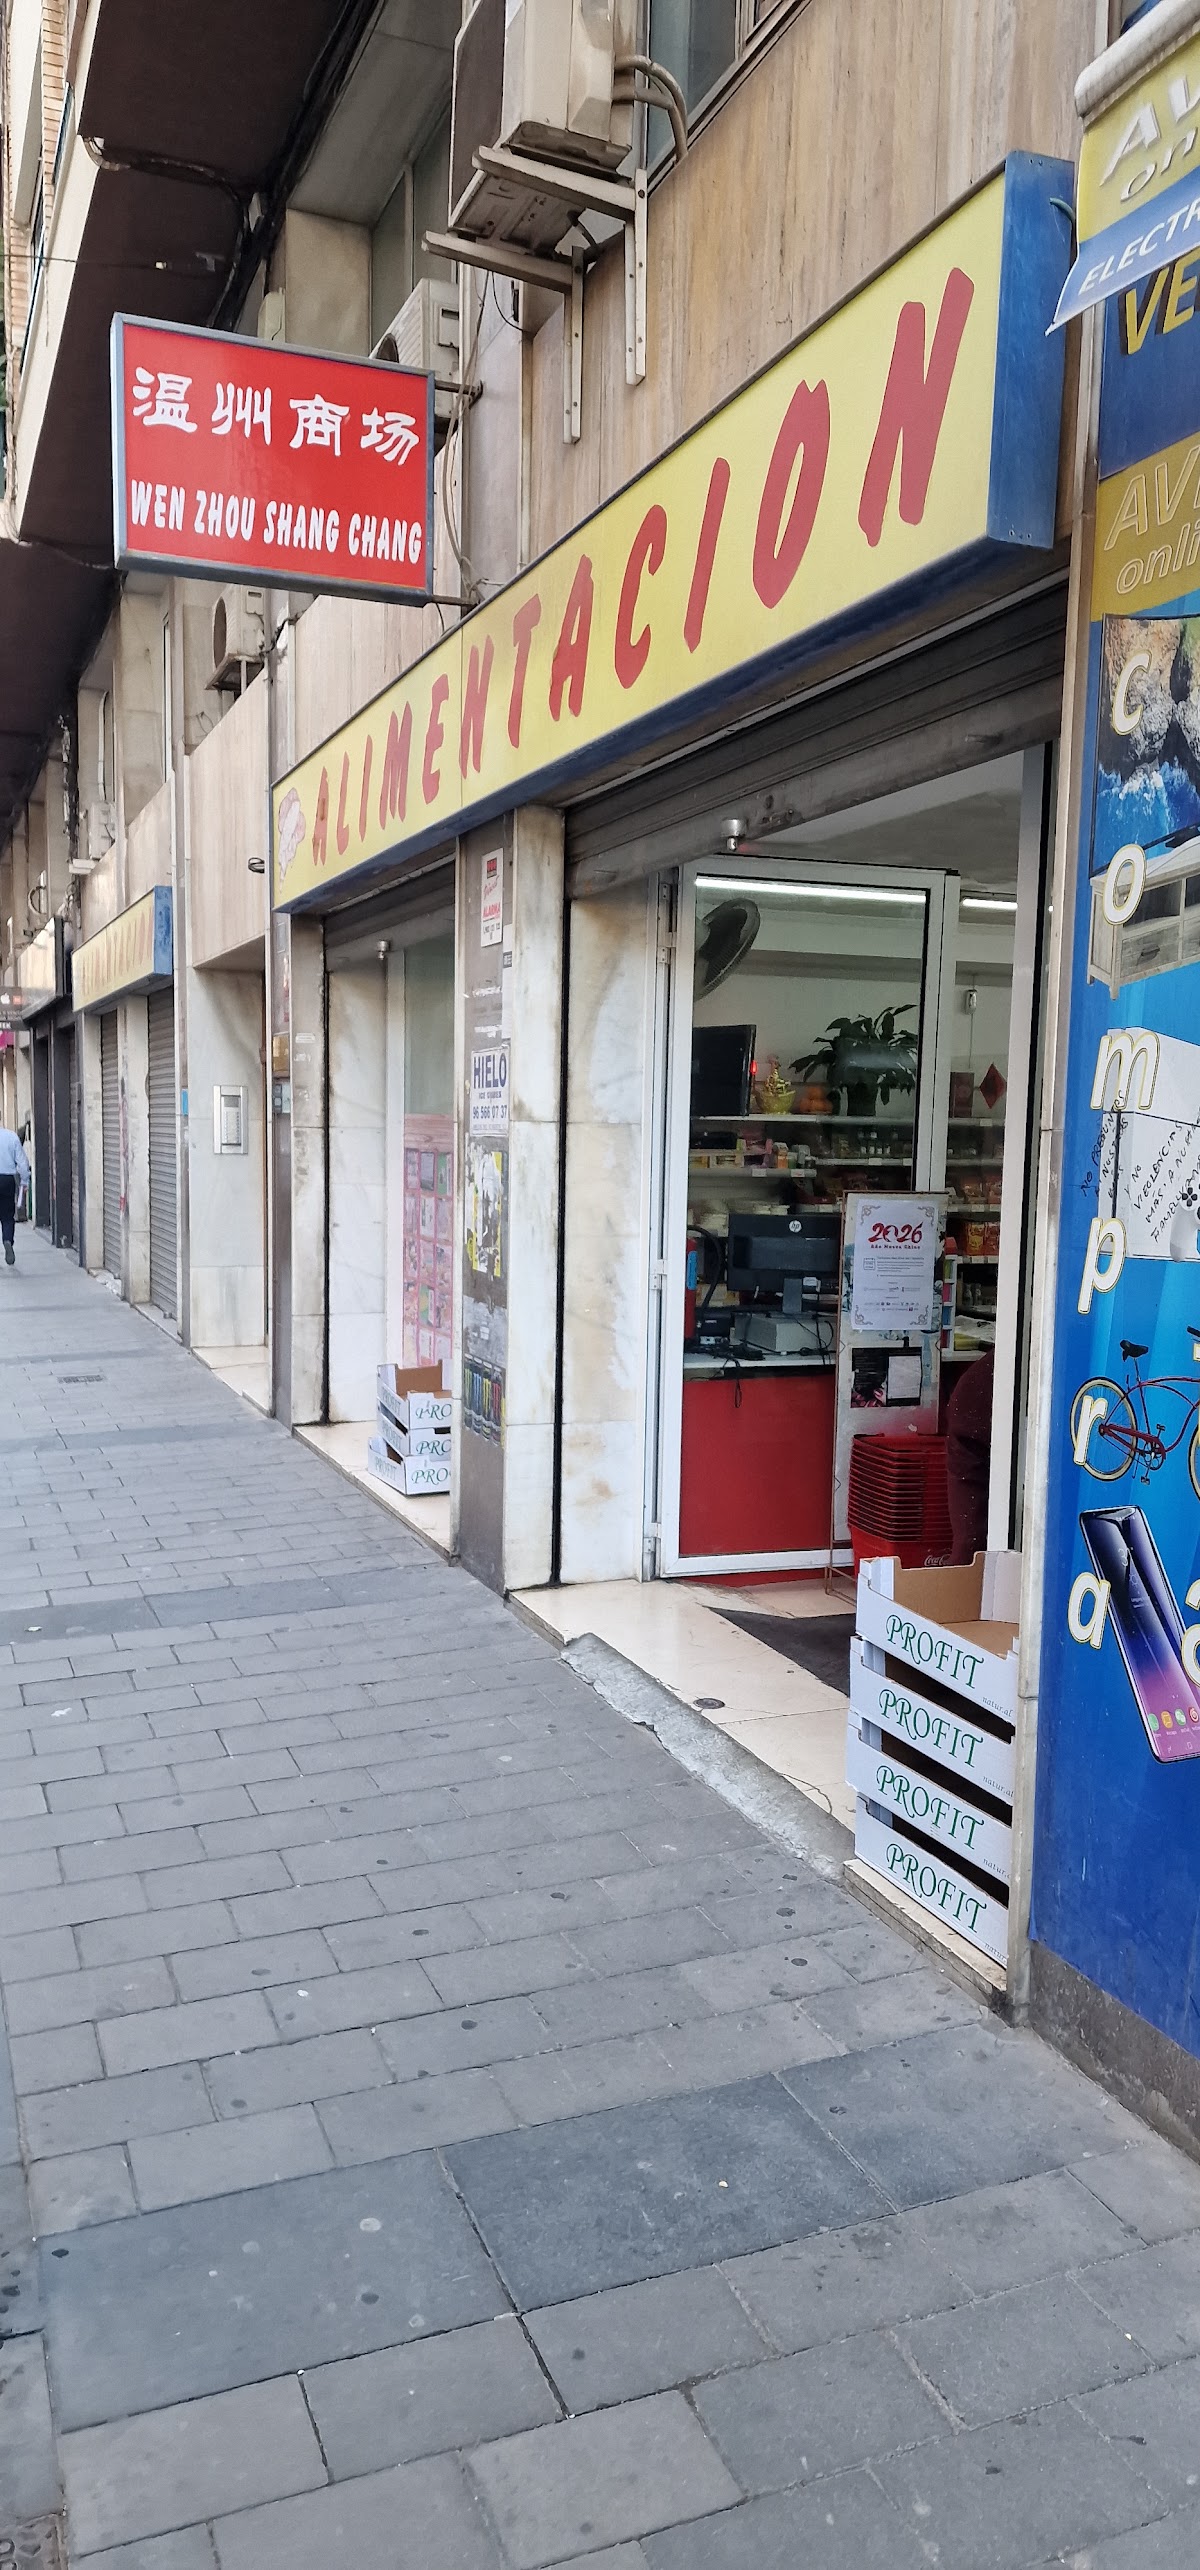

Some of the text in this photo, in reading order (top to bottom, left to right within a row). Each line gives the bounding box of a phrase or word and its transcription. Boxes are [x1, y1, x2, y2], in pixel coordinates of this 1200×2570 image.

[132, 366, 420, 466] 温州商场
[131, 479, 423, 564] WEN ZHOU SHANG CHANG
[311, 267, 975, 866] ALIMENTACION
[473, 1052, 507, 1089] HIELO
[867, 1221, 924, 1244] 2026
[885, 1614, 985, 1689] PROFIT
[878, 1688, 984, 1769] PROFIT
[876, 1765, 985, 1850] PROFIT
[886, 1843, 987, 1934] PROFIT
